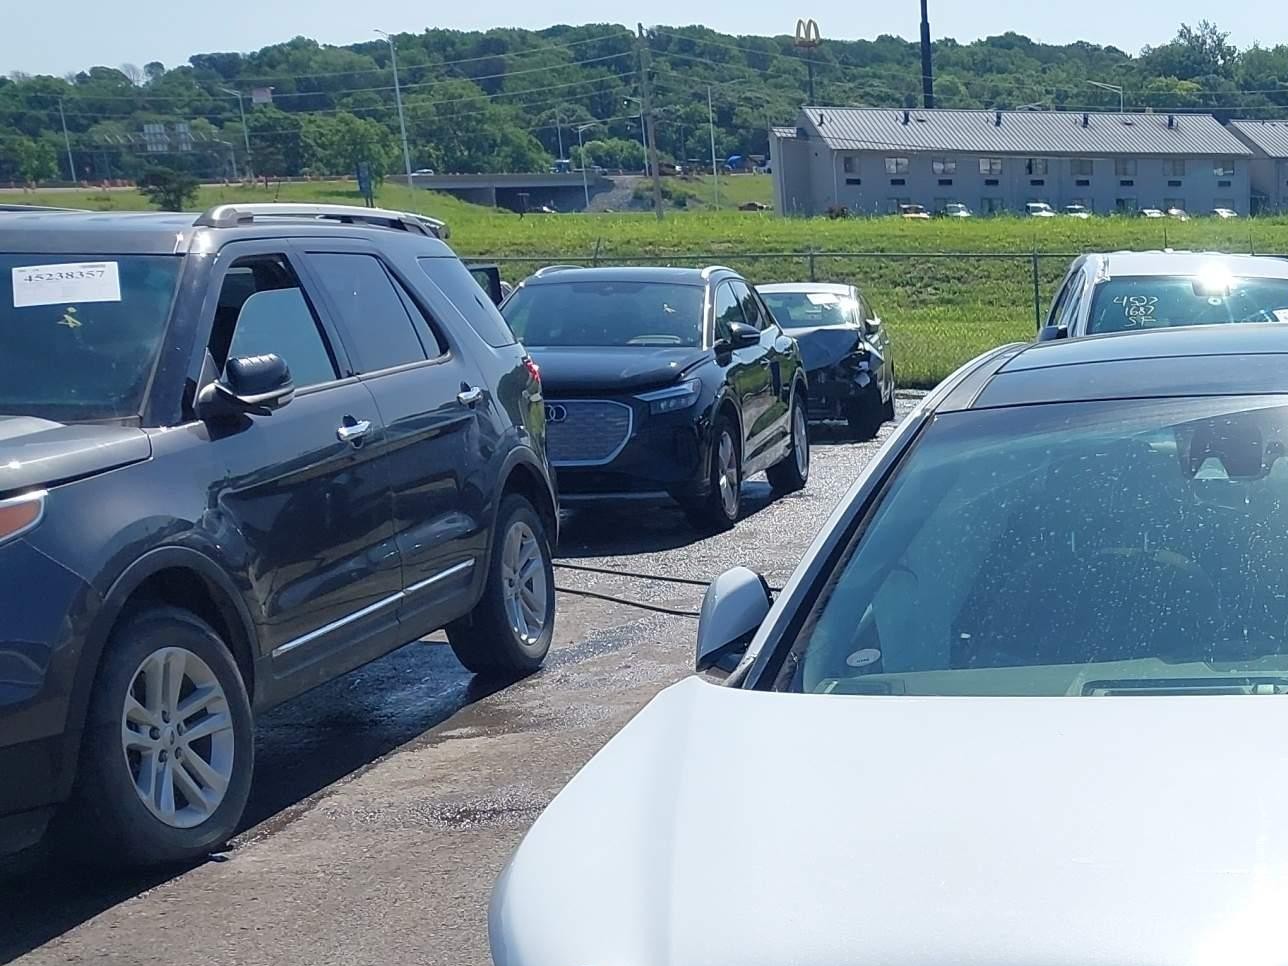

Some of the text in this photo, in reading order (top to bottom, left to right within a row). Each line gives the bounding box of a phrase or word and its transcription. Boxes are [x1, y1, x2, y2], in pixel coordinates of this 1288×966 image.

[24, 270, 105, 283] 45238357
[1113, 295, 1159, 307] 4527
[1125, 305, 1155, 316] 1687
